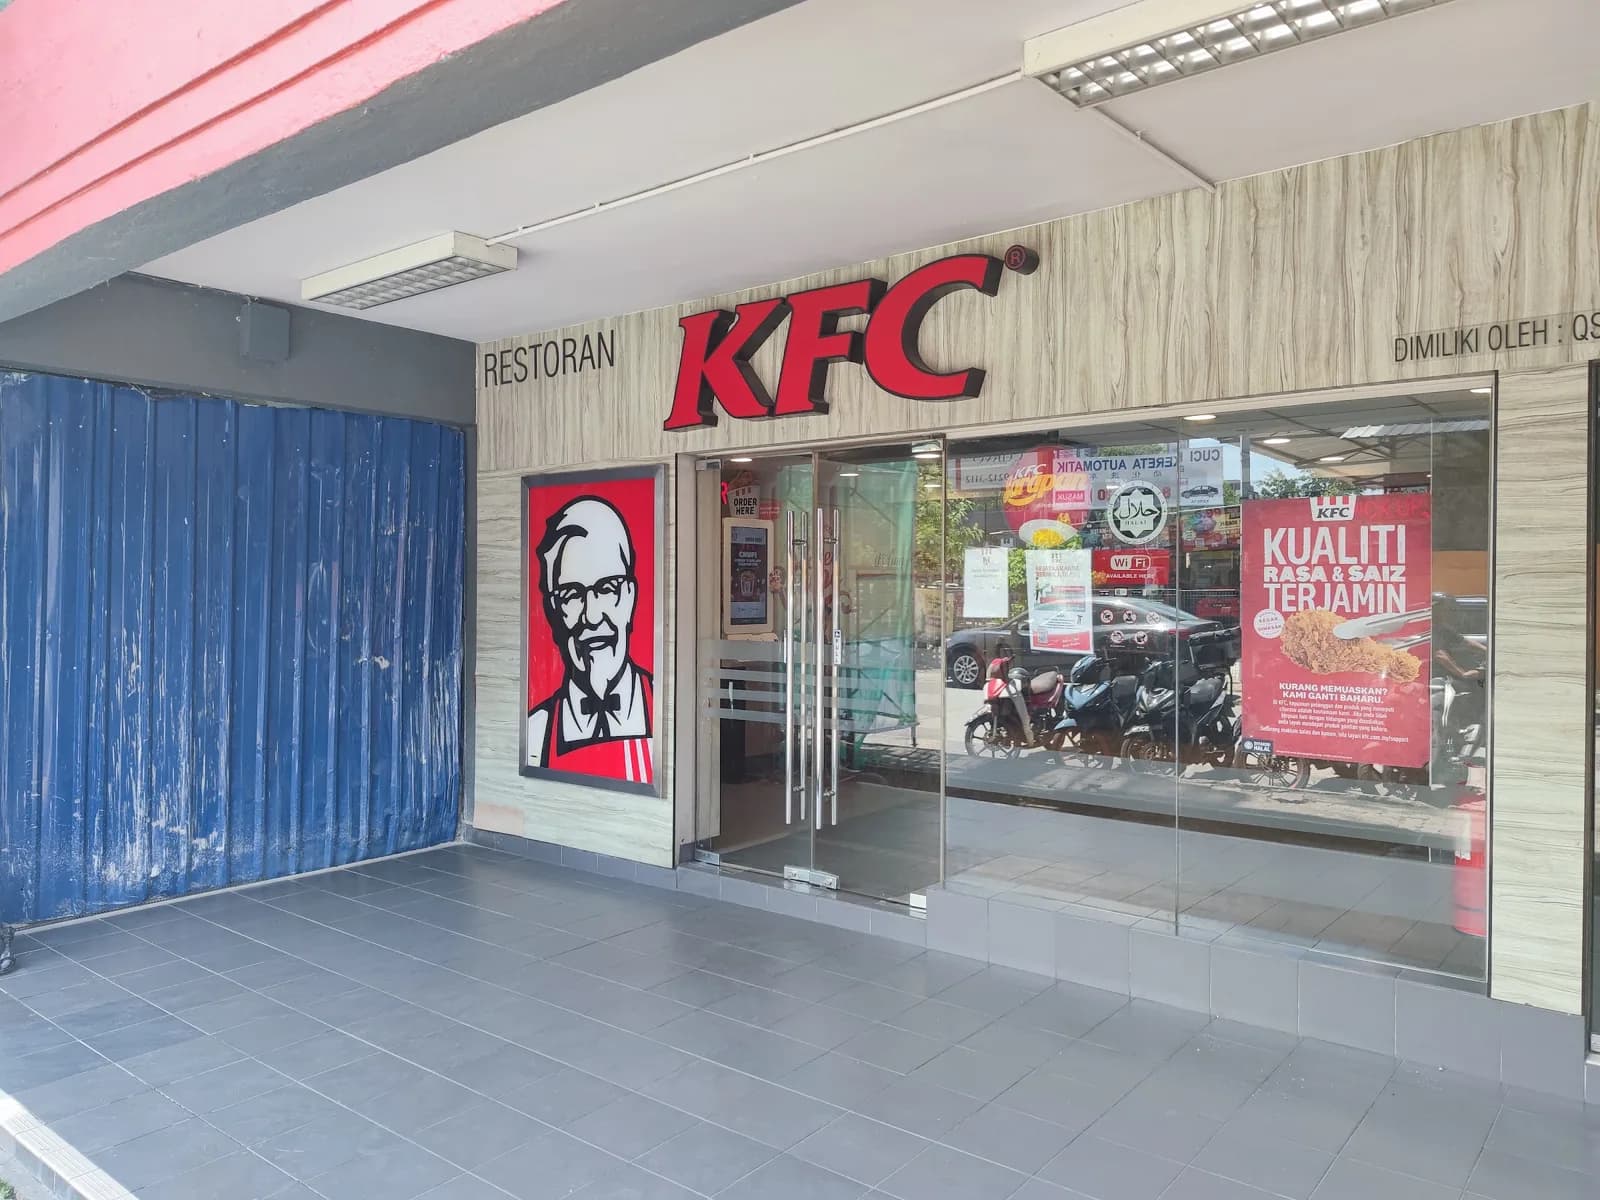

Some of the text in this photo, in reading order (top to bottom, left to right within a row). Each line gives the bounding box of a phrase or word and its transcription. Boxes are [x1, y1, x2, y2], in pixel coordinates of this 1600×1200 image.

[664, 253, 1005, 432] KFC
[1394, 328, 1479, 362] DIMILIKI
[1488, 319, 1548, 351] OLEH
[483, 330, 615, 388] RESTORAN
[1014, 464, 1047, 480] KFC
[733, 497, 758, 507] ORDER
[735, 506, 755, 515] HERE
[1316, 507, 1350, 519] KFC
[1263, 524, 1406, 565] KUALITI
[1263, 565, 1406, 583] RASA & SAIZ
[1263, 583, 1406, 613] TERJAMIN
[1279, 682, 1388, 696] KURANG MEMUASKAN?
[1282, 691, 1384, 704] KAMI GANTI BAHARU.
